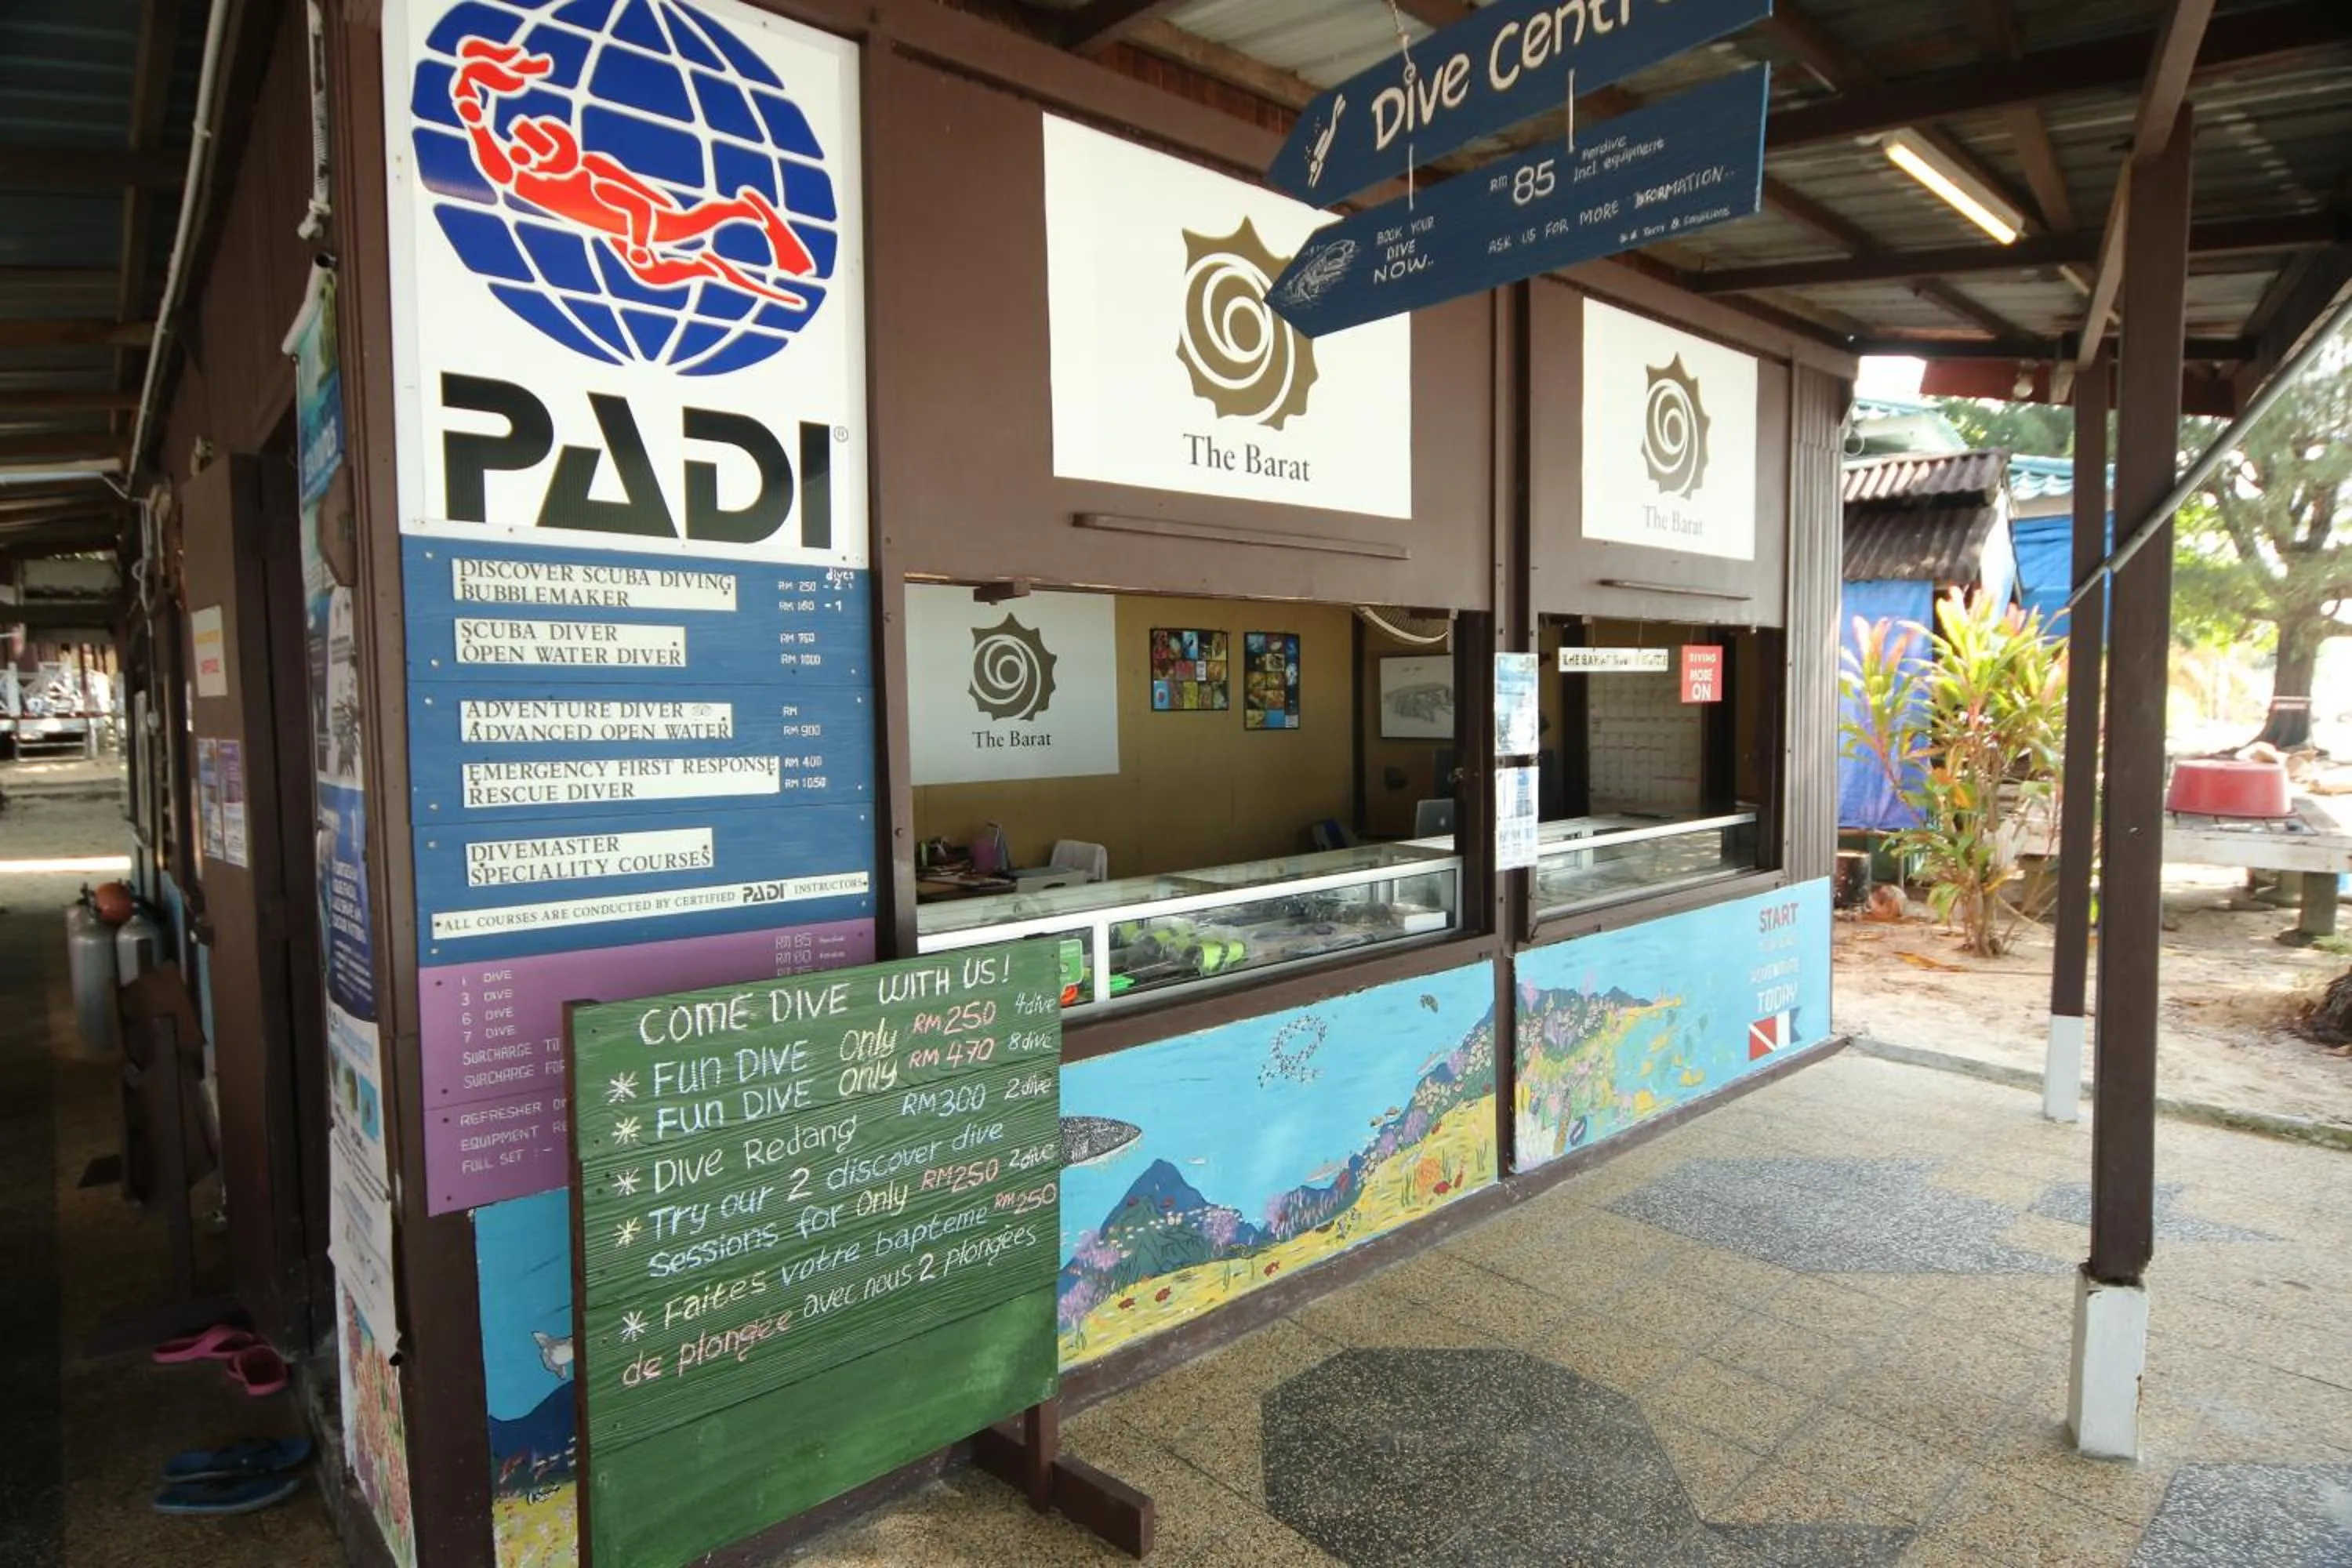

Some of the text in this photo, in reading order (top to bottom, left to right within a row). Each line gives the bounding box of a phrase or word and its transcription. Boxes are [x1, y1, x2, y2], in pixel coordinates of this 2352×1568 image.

[1371, 52, 1471, 151] Dive
[1513, 158, 1556, 207] 85
[1488, 235, 1512, 254] ASK
[1522, 226, 1535, 244] US
[1545, 219, 1569, 238] FOR
[1580, 201, 1619, 227] MORE
[1387, 238, 1415, 261] DIVE
[441, 371, 832, 549] PADI
[1182, 433, 1310, 482] The Barat
[1642, 504, 1703, 536] The Barat
[461, 560, 731, 590] DISCOVER SCUBA DIVING
[461, 583, 629, 606] BUBBLEMAKER
[461, 622, 618, 641] SCUBA DIVER
[463, 644, 681, 665] OPEN WATER DIVER
[1692, 683, 1711, 700] ON
[466, 702, 684, 719] ADVENTURE DIVER
[468, 723, 730, 741] ADVANCED OPEN WATER
[971, 730, 1051, 748] The Barat
[468, 757, 776, 782] EMERGENCY FIRST RESPONSE
[469, 782, 636, 805] RESCUE DIVER
[471, 837, 620, 862] DIVEMASTER
[470, 850, 711, 885] SPECIALITY COURSES
[445, 878, 863, 932] ALL COURSES ARE CONDUCTED BY CERTIFIED PADI INSTRUCTORS
[1759, 902, 1798, 933] START
[483, 970, 513, 983] DIVE
[461, 989, 513, 1006] 3 DIVE
[640, 993, 753, 1045] COME
[769, 983, 851, 1023] DIVE
[878, 967, 949, 1004] WITH
[1757, 982, 1798, 1014] TODAY
[462, 1007, 514, 1025] 6 DIVE
[463, 1025, 515, 1044] 7 DIVE
[463, 1043, 533, 1066] SURCHARGE
[735, 1040, 808, 1083] DIVE
[464, 1065, 534, 1089] SURCHARGE
[743, 1079, 814, 1120] DIVE
[460, 1102, 542, 1127] REFRESHER
[461, 1125, 539, 1152] EQUIPMENT
[743, 1114, 858, 1171] Redang
[462, 1149, 524, 1174] FULL SET
[648, 1122, 1004, 1241] Try our 2 discover dive
[796, 1203, 844, 1240] for
[665, 1270, 767, 1330] Faites
[781, 1242, 860, 1287] votre
[622, 1350, 662, 1388] de
[803, 1283, 858, 1319] avec
[863, 1264, 913, 1299] nous
[918, 1254, 935, 1282] 2
